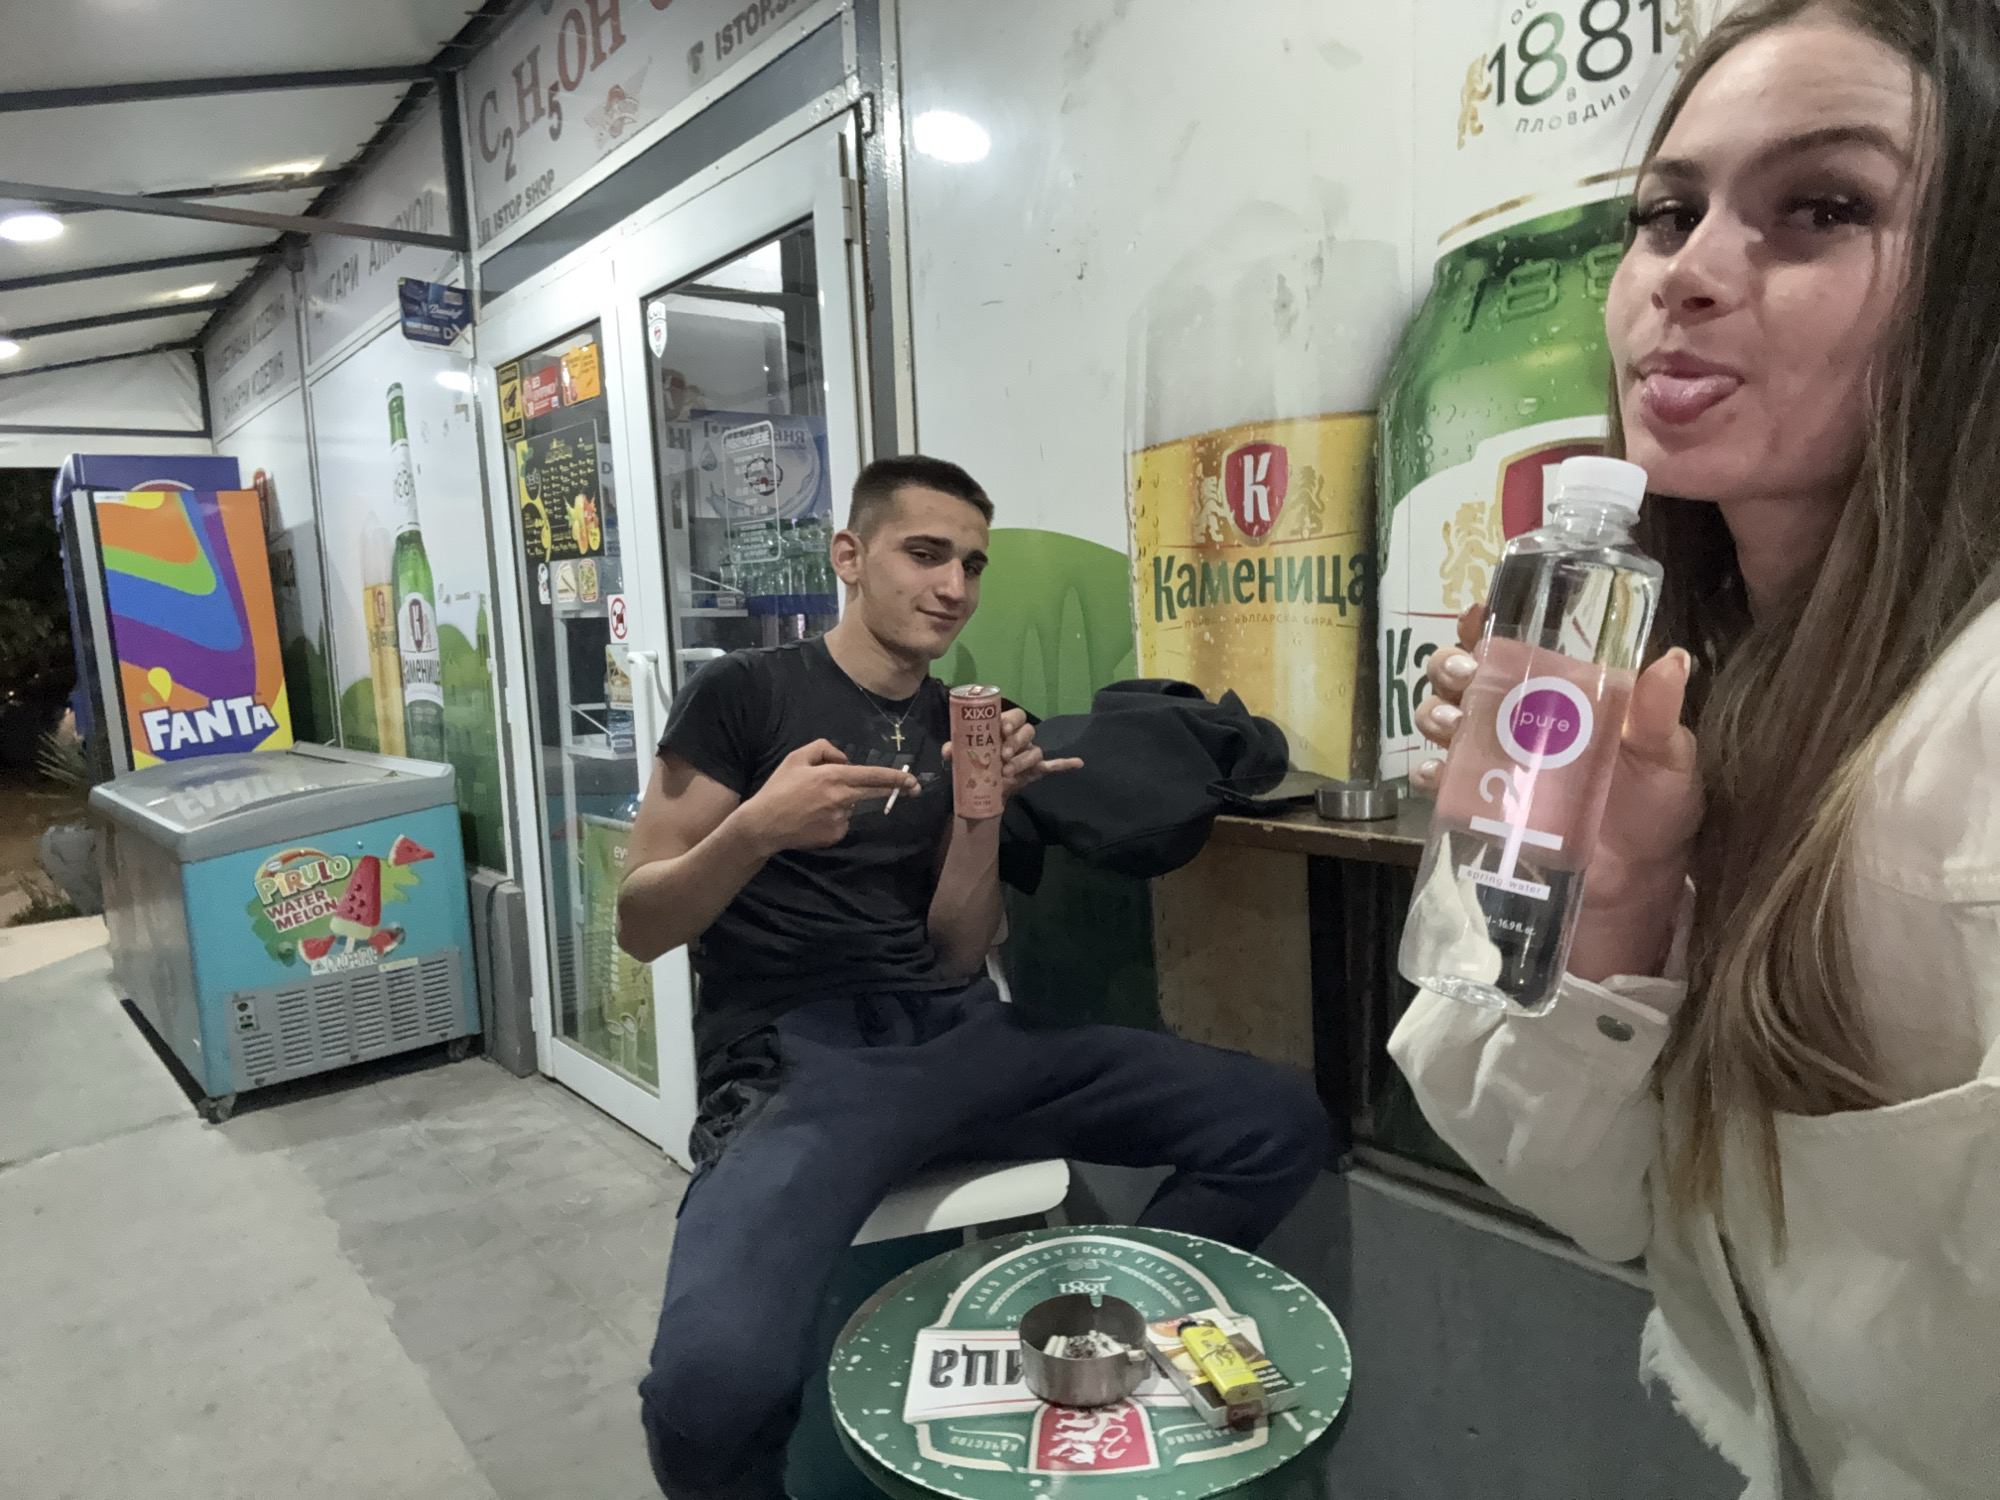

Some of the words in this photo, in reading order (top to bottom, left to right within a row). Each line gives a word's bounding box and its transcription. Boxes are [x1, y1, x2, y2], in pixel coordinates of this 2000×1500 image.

[1487, 0, 1662, 107] 1881
[1515, 85, 1632, 134] ПЛОВДИВ
[525, 168, 555, 208] SHOP
[1153, 554, 1378, 622] Каменица
[142, 695, 276, 752] FANTA
[963, 705, 995, 720] XIXO
[969, 724, 991, 732] ICE
[1518, 708, 1571, 734] pure
[965, 734, 995, 747] TEA
[255, 855, 351, 905] PIRULO
[1466, 870, 1503, 887] spring
[1509, 881, 1541, 895] water
[265, 889, 327, 920] WATER
[275, 898, 338, 932] MELON
